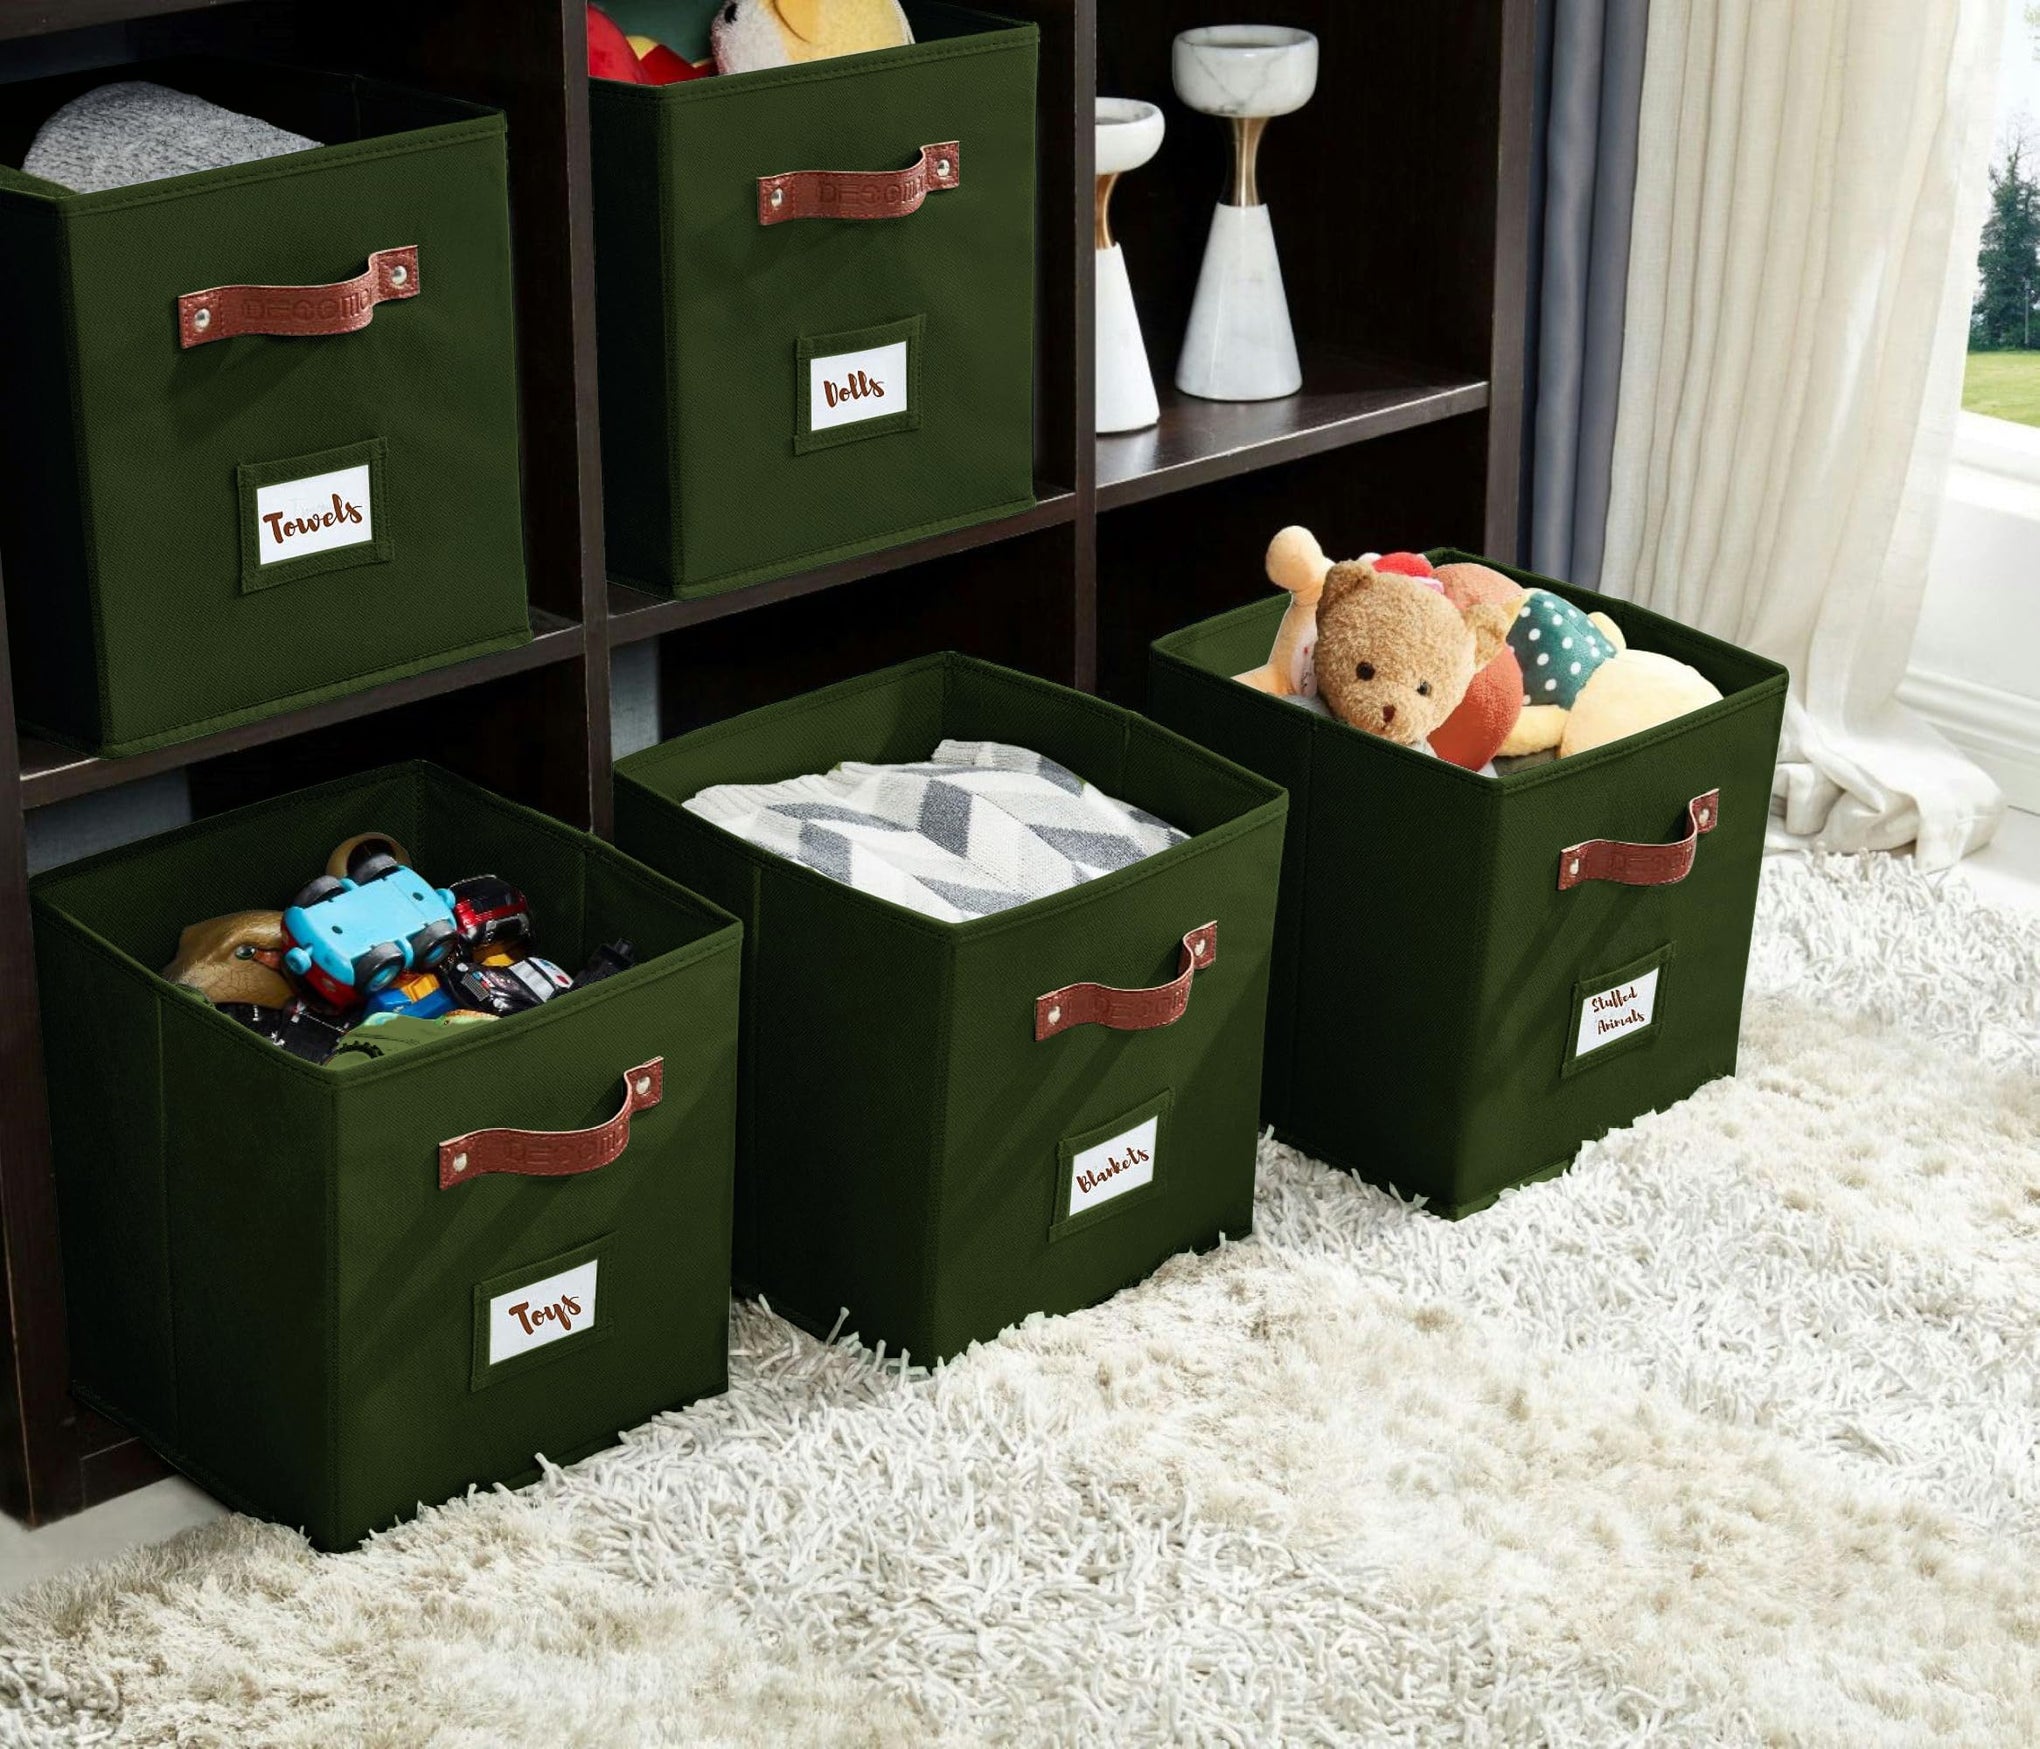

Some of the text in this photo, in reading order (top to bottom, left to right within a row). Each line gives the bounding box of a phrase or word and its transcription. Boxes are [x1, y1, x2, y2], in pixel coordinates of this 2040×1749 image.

[823, 370, 885, 408] Dolls
[262, 493, 363, 544] Towels
[1591, 986, 1638, 1013] Stuffed
[1598, 1009, 1645, 1035] Animals
[1076, 1147, 1150, 1194] Blankets
[508, 1294, 582, 1335] Toys
